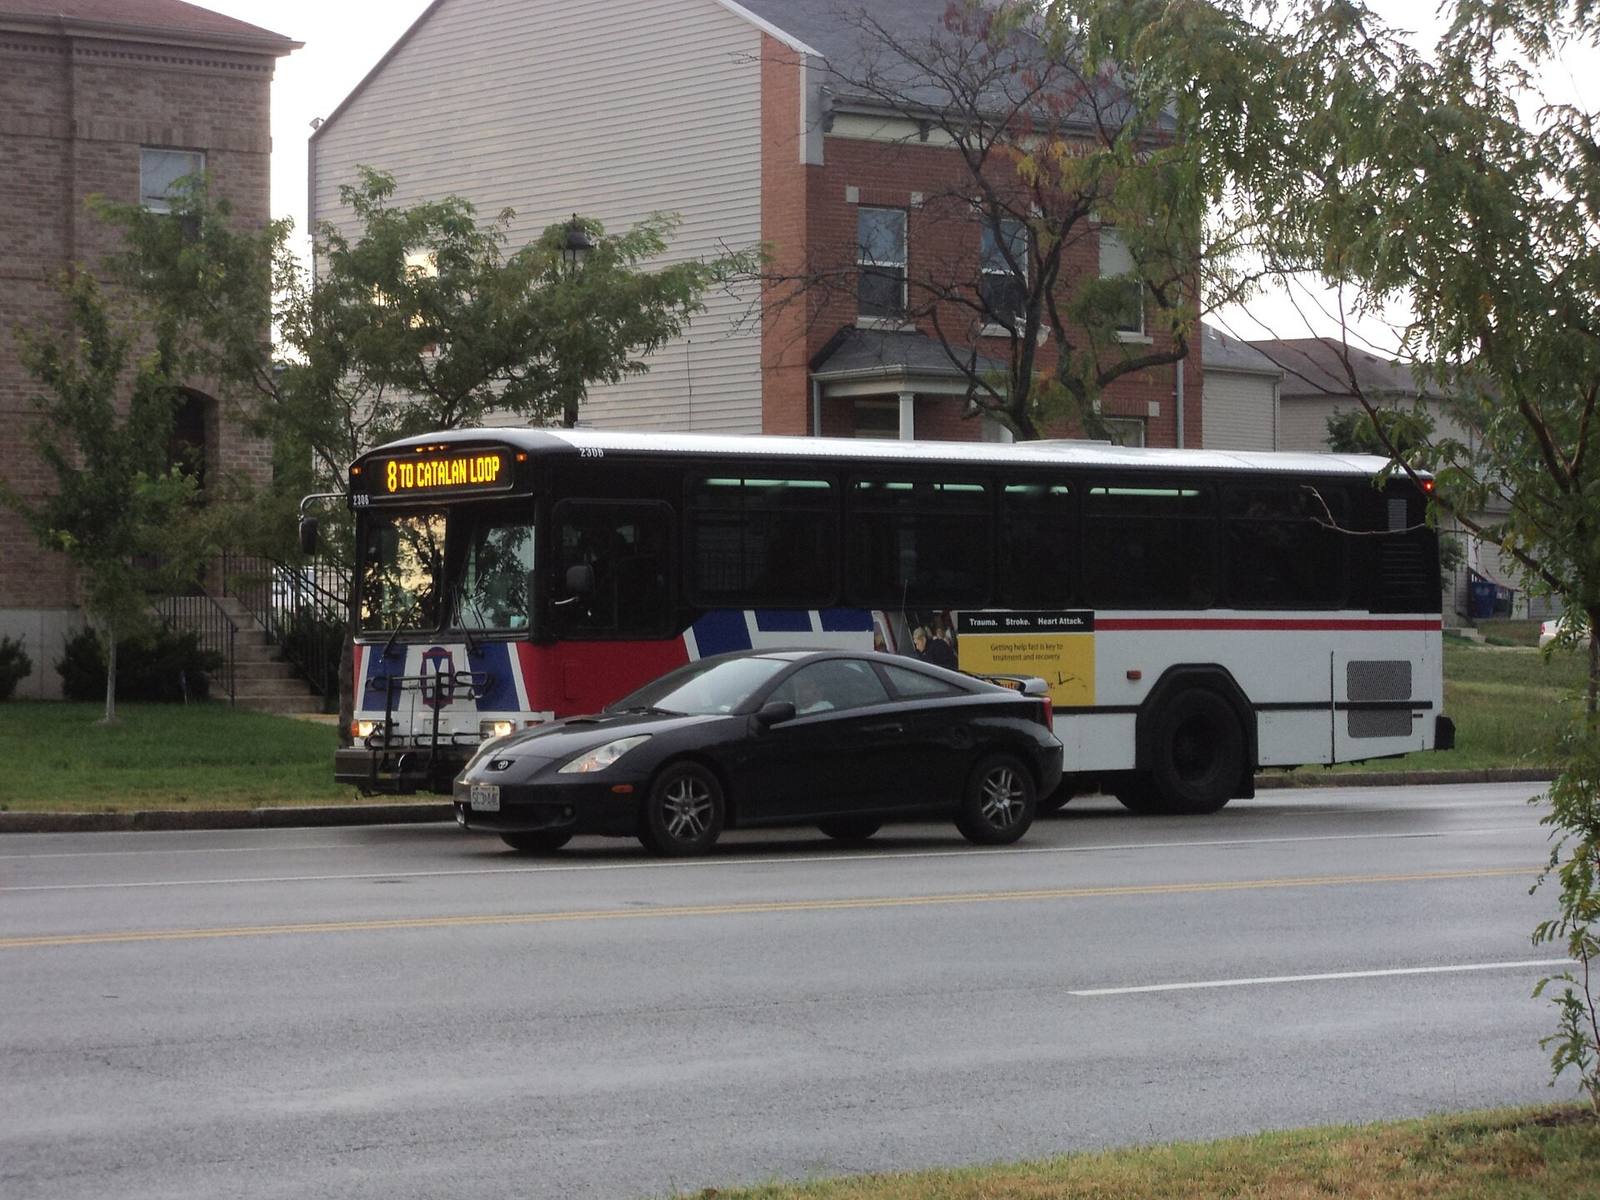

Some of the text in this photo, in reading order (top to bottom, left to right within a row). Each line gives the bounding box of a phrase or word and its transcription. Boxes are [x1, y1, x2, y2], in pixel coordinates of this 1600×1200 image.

[387, 455, 500, 492] 8 TO CATALAN LOOP
[969, 617, 1084, 626] Trauma. Stroke. Heart Attack.
[990, 643, 1013, 652] Getting
[1014, 643, 1027, 651] help
